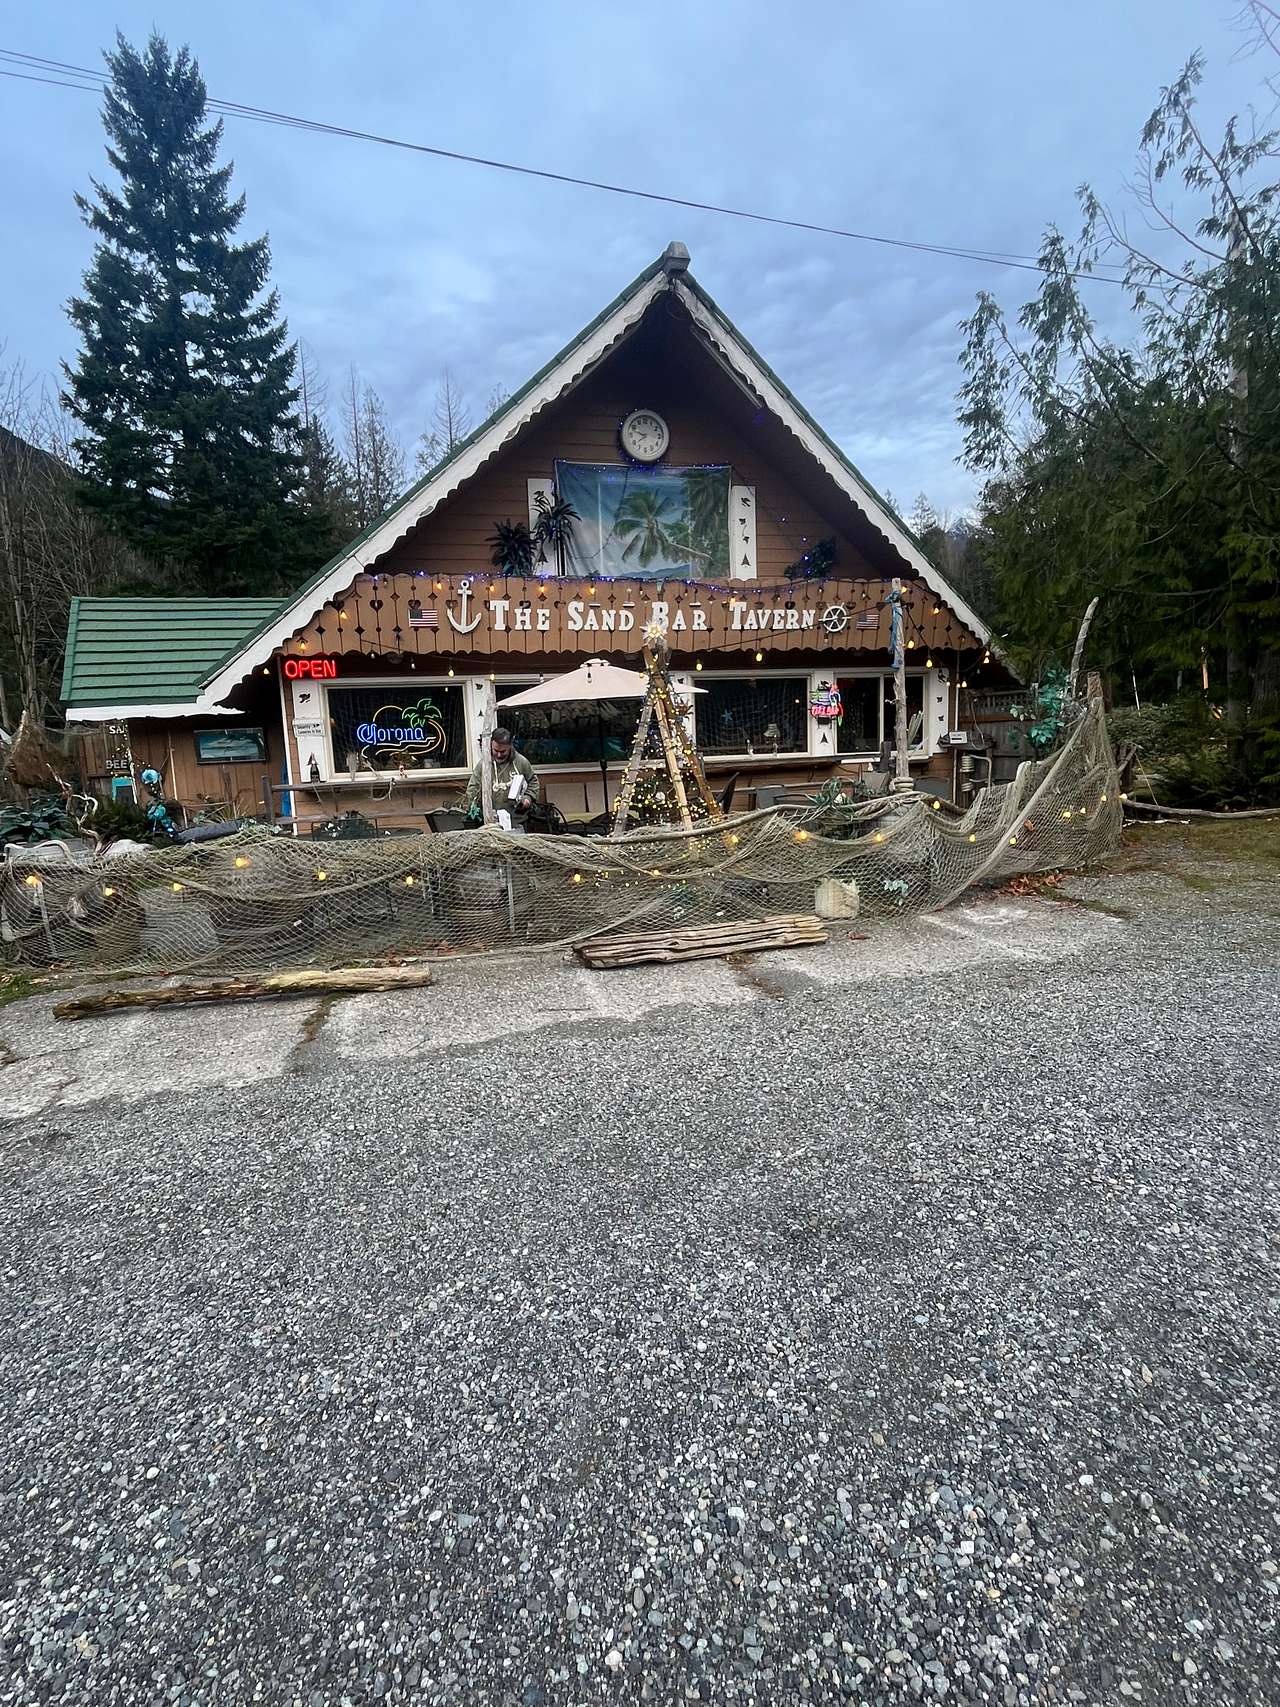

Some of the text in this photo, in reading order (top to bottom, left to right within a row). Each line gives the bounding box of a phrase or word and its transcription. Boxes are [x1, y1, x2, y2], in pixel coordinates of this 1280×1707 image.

[489, 600, 816, 631] THE SAND BAR TAVERN
[285, 659, 336, 678] OPEN
[357, 723, 425, 745] Corona
